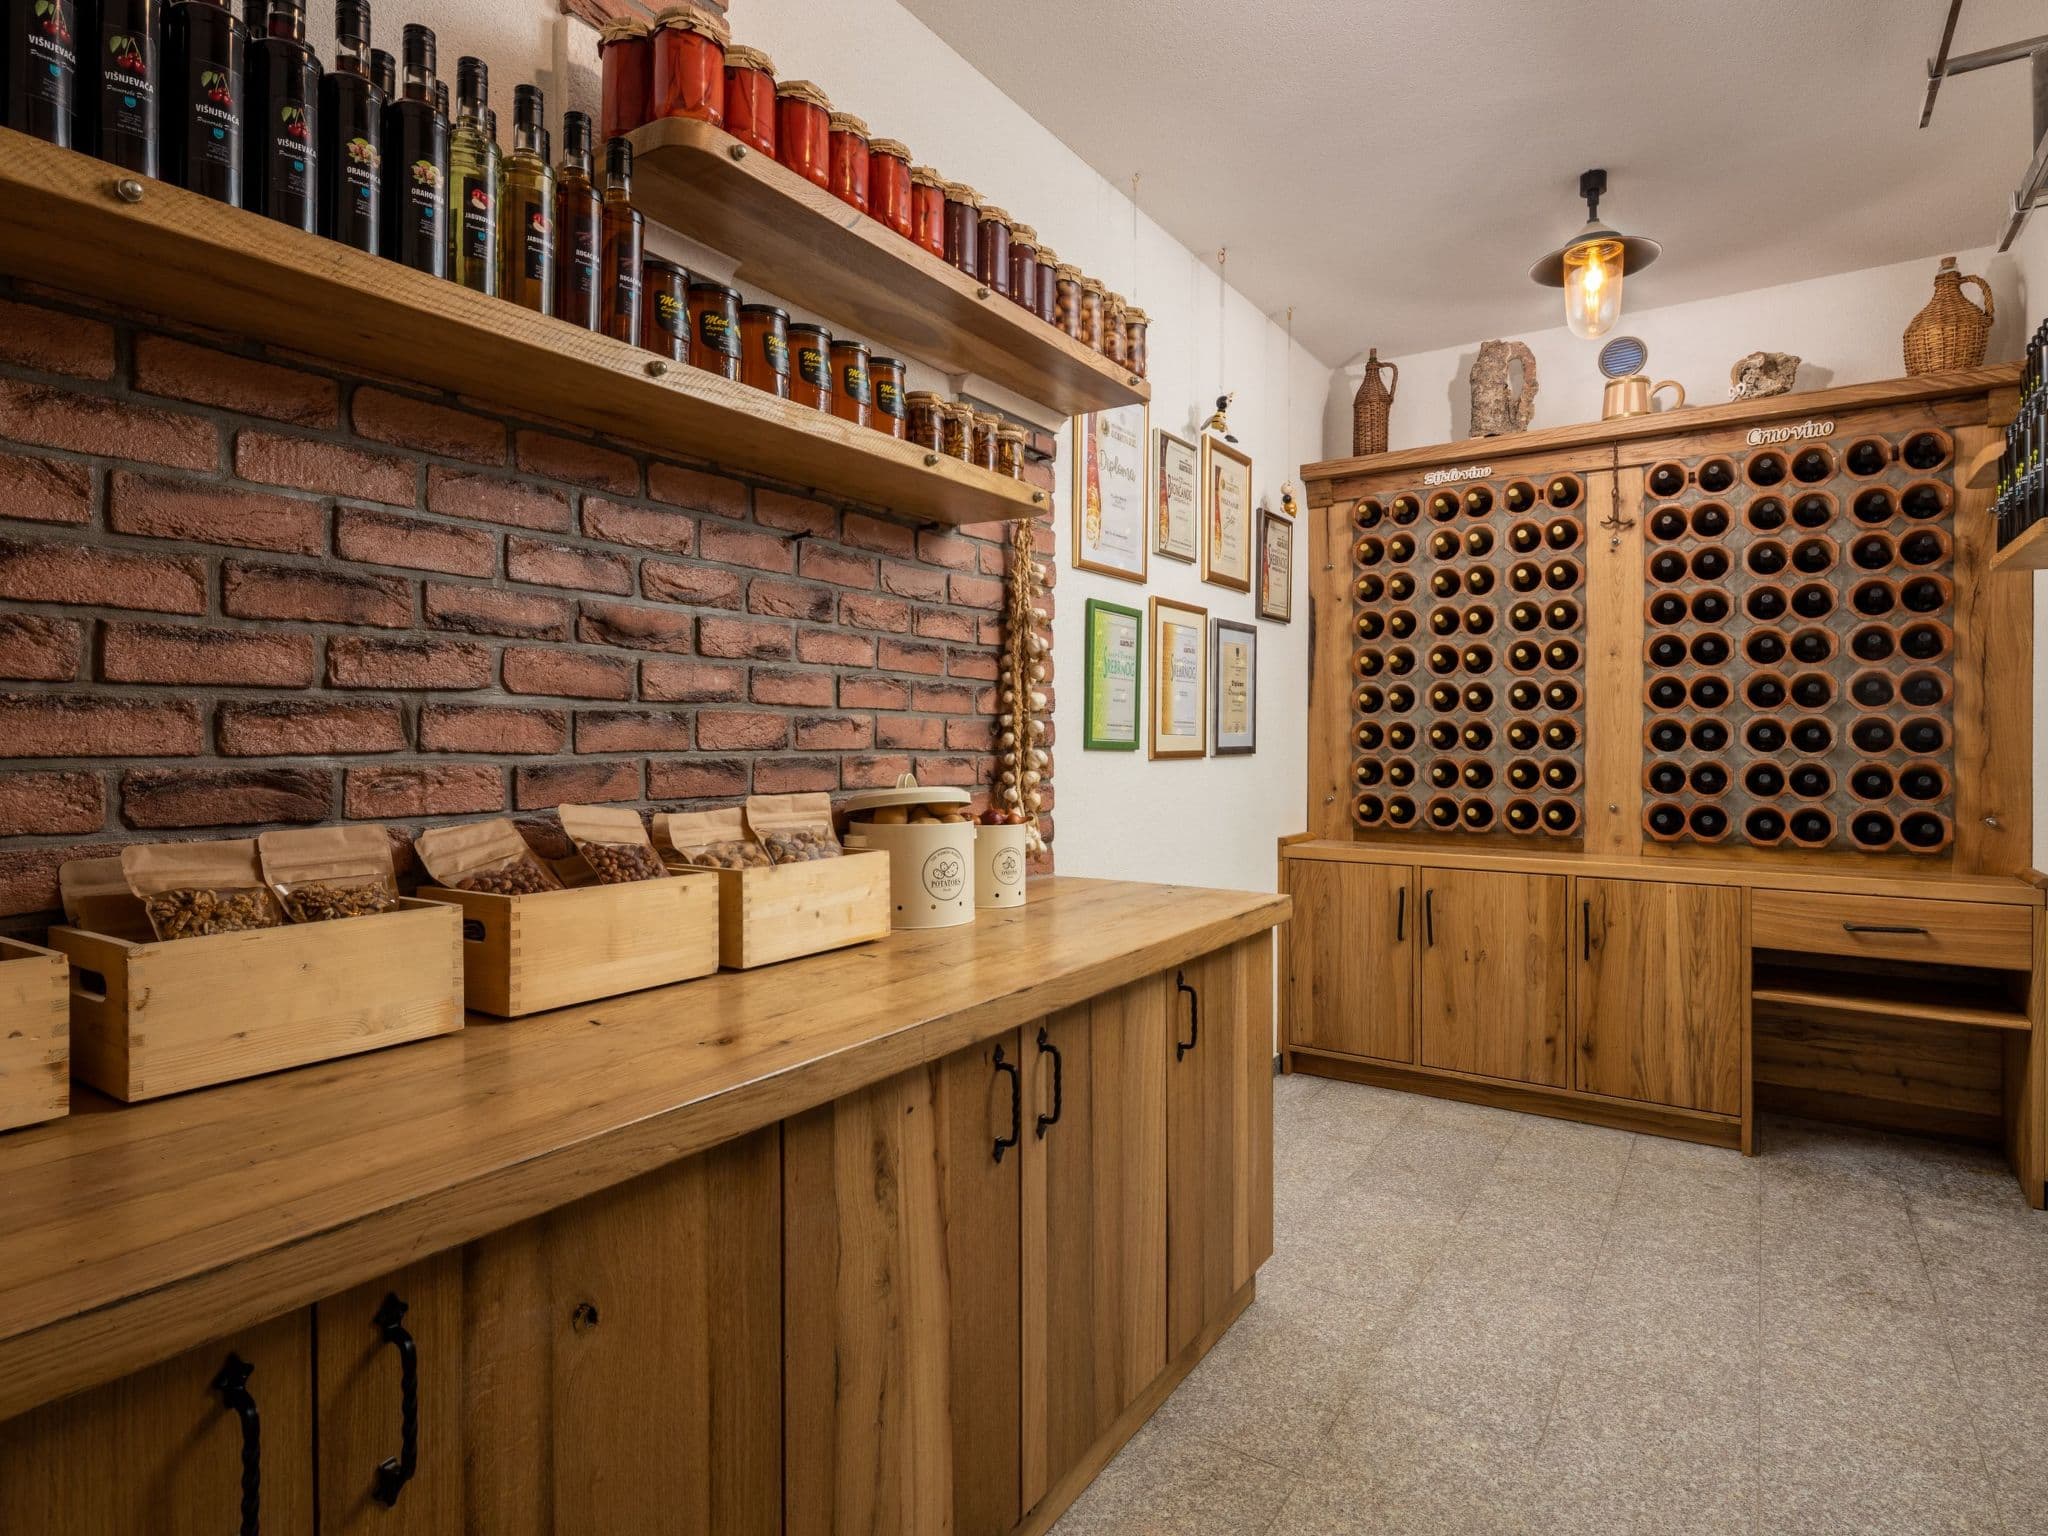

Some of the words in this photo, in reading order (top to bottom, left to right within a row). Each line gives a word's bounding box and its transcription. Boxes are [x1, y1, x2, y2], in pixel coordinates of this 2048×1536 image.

[660, 294, 683, 309] Med
[705, 314, 729, 326] Med
[1747, 428, 1790, 446] Crno
[1791, 420, 1835, 440] vino
[1461, 466, 1492, 480] vino
[931, 879, 961, 888] POTATOES
